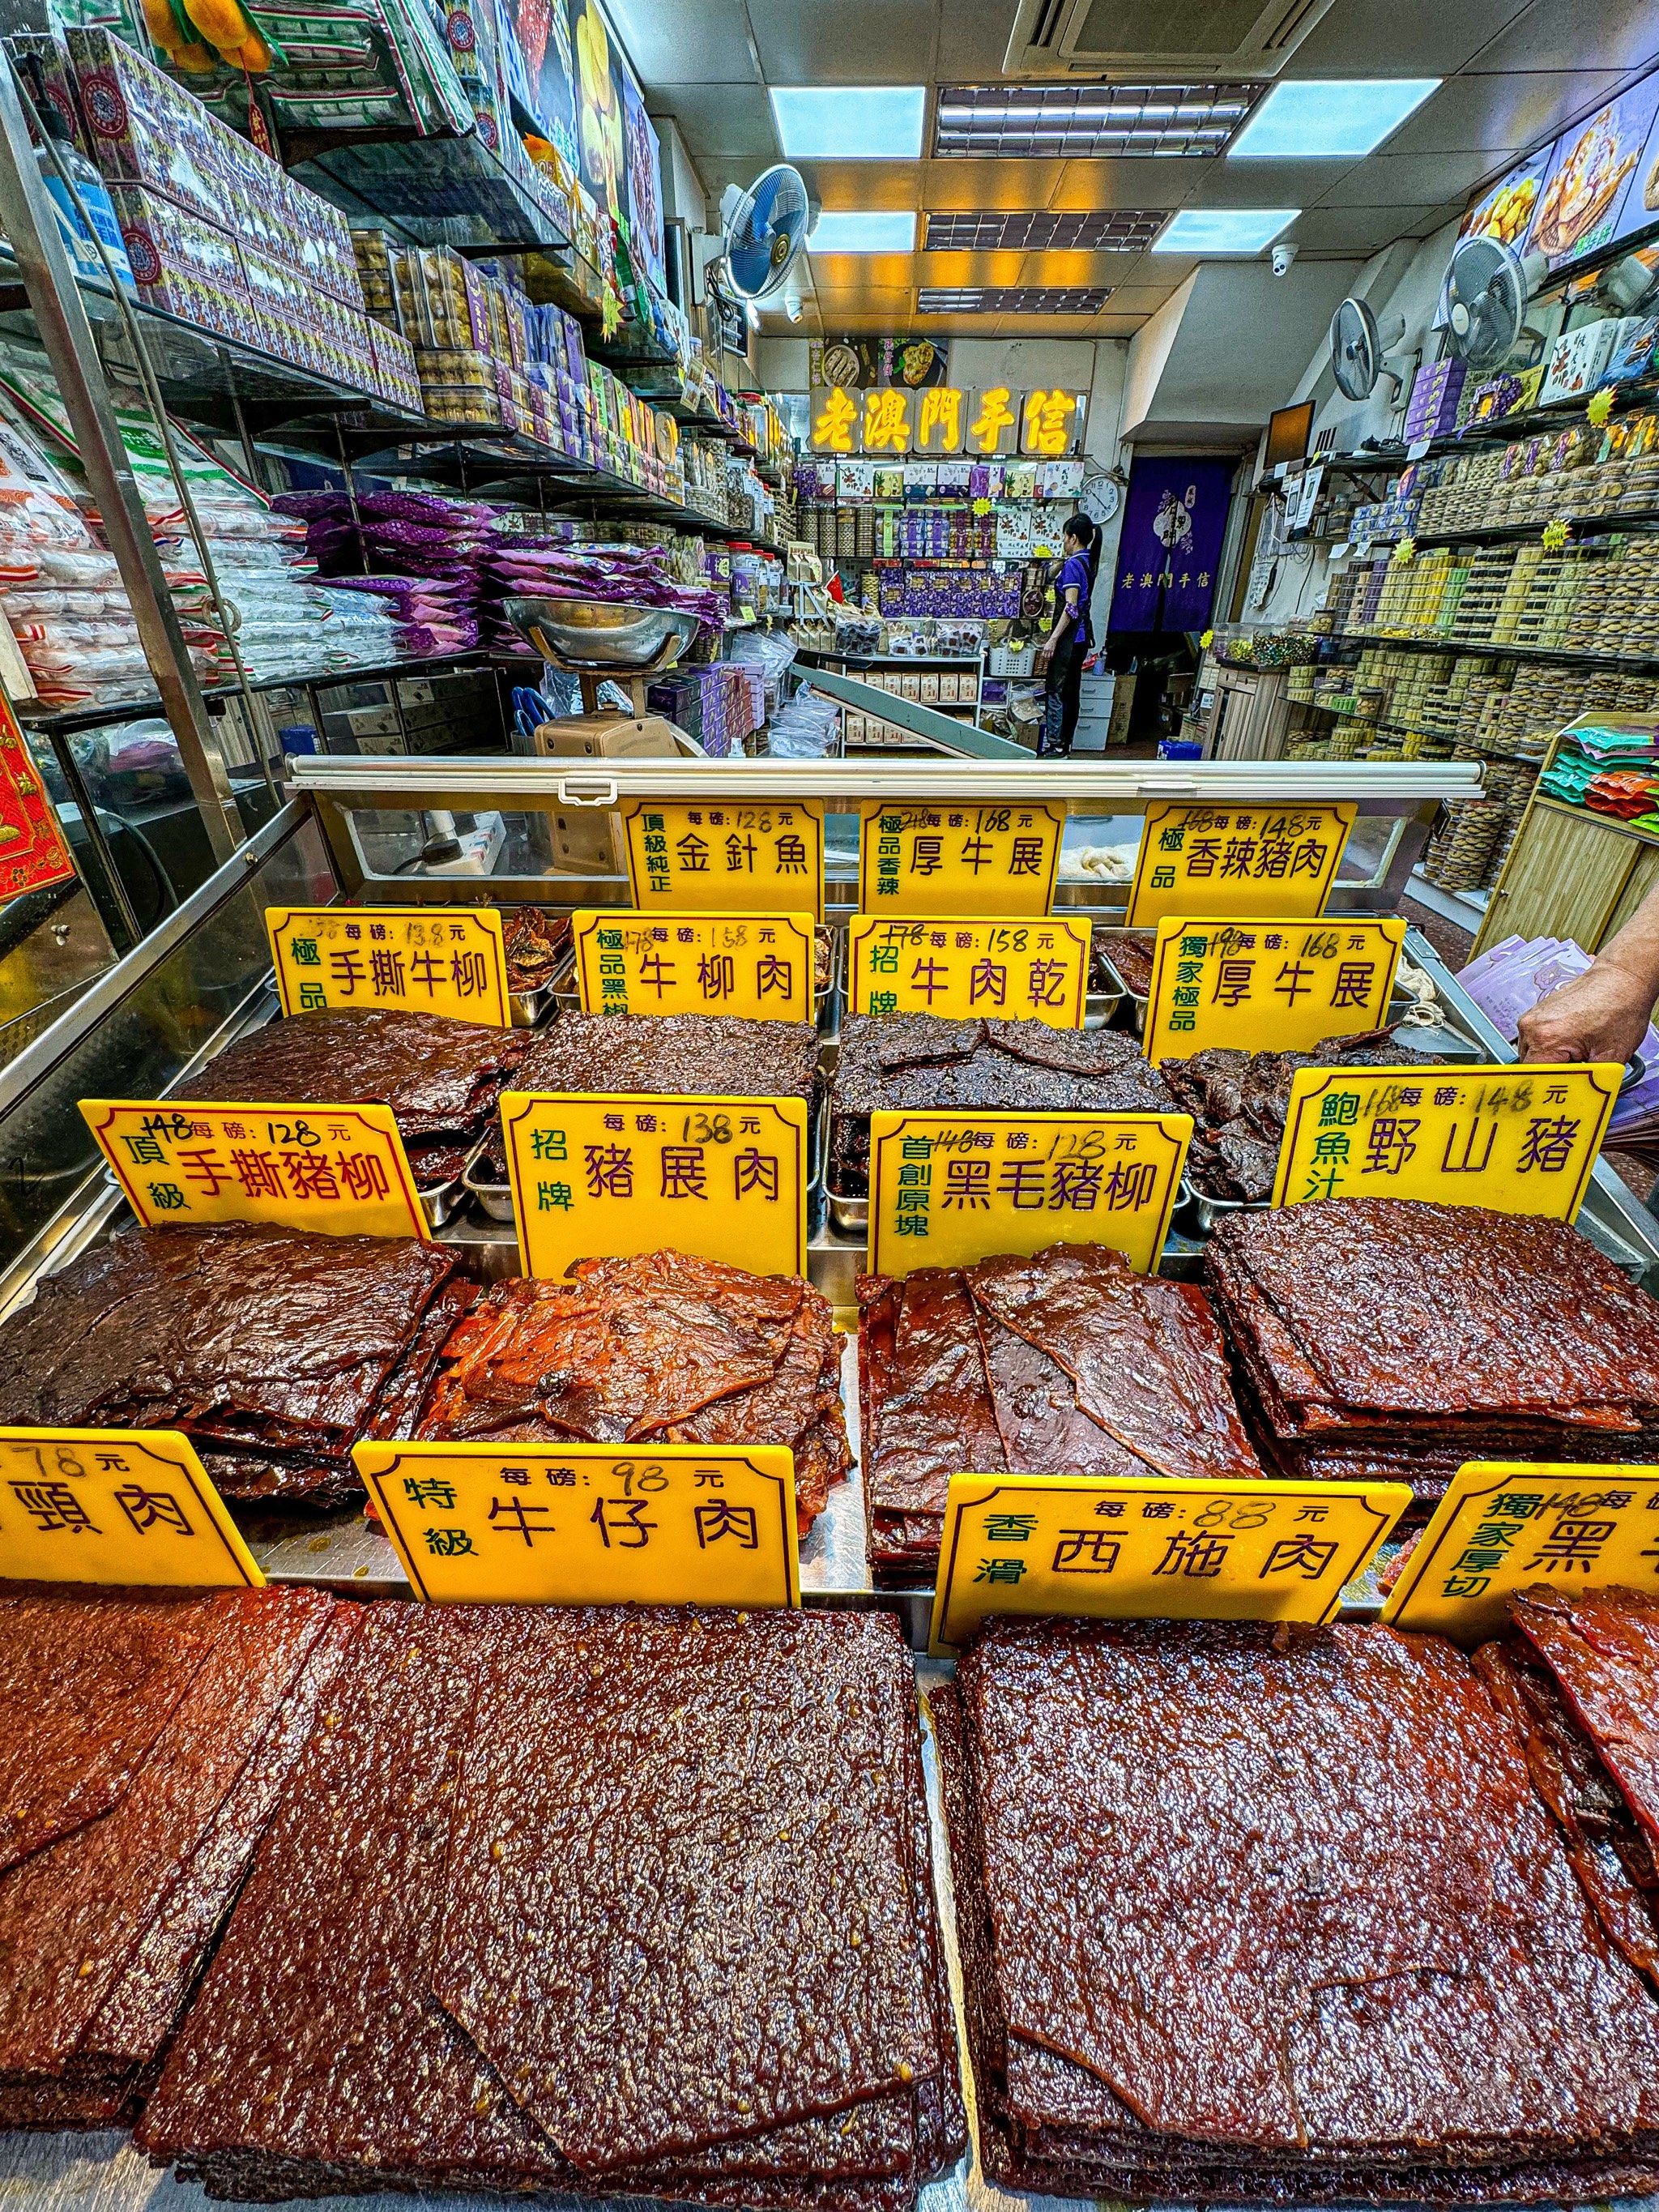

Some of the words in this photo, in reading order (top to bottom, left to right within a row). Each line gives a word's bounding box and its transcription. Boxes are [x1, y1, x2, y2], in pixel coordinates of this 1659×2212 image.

[813, 386, 1077, 454] 老澳門手信
[1121, 572, 1210, 589] 老澳門手信
[642, 813, 672, 892] 頂級純正
[676, 832, 808, 874] 金針魚
[877, 814, 901, 895] 極品香辣
[910, 835, 1044, 877] 厚牛展
[1150, 827, 1184, 889] 極品
[1187, 837, 1328, 879] 香辣豬肉
[292, 937, 328, 1010] 極品
[330, 950, 488, 999] 手撕牛柳
[639, 954, 792, 1000] 牛柳肉
[870, 945, 898, 1015] 招牌
[911, 959, 1065, 1007] 牛肉乾
[1169, 936, 1209, 1031] 獨家極品
[1211, 959, 1375, 1008] 厚牛展
[121, 1135, 190, 1210] 頂級
[177, 1147, 390, 1201] 手撕豬柳
[531, 1129, 574, 1211] 招牌
[583, 1143, 778, 1202] 豬展肉
[1303, 1094, 1361, 1199] 鮑魚汁
[1361, 1116, 1580, 1175] 野山豬
[895, 1135, 932, 1236] 首創原塊
[941, 1159, 1158, 1212] 黑毛豬柳
[403, 1477, 480, 1557] 特級
[488, 1497, 759, 1550] 牛仔肉
[1441, 1493, 1542, 1599] 獨家厚切
[972, 1514, 1038, 1585] 香滑
[1051, 1530, 1339, 1579] 西施肉
